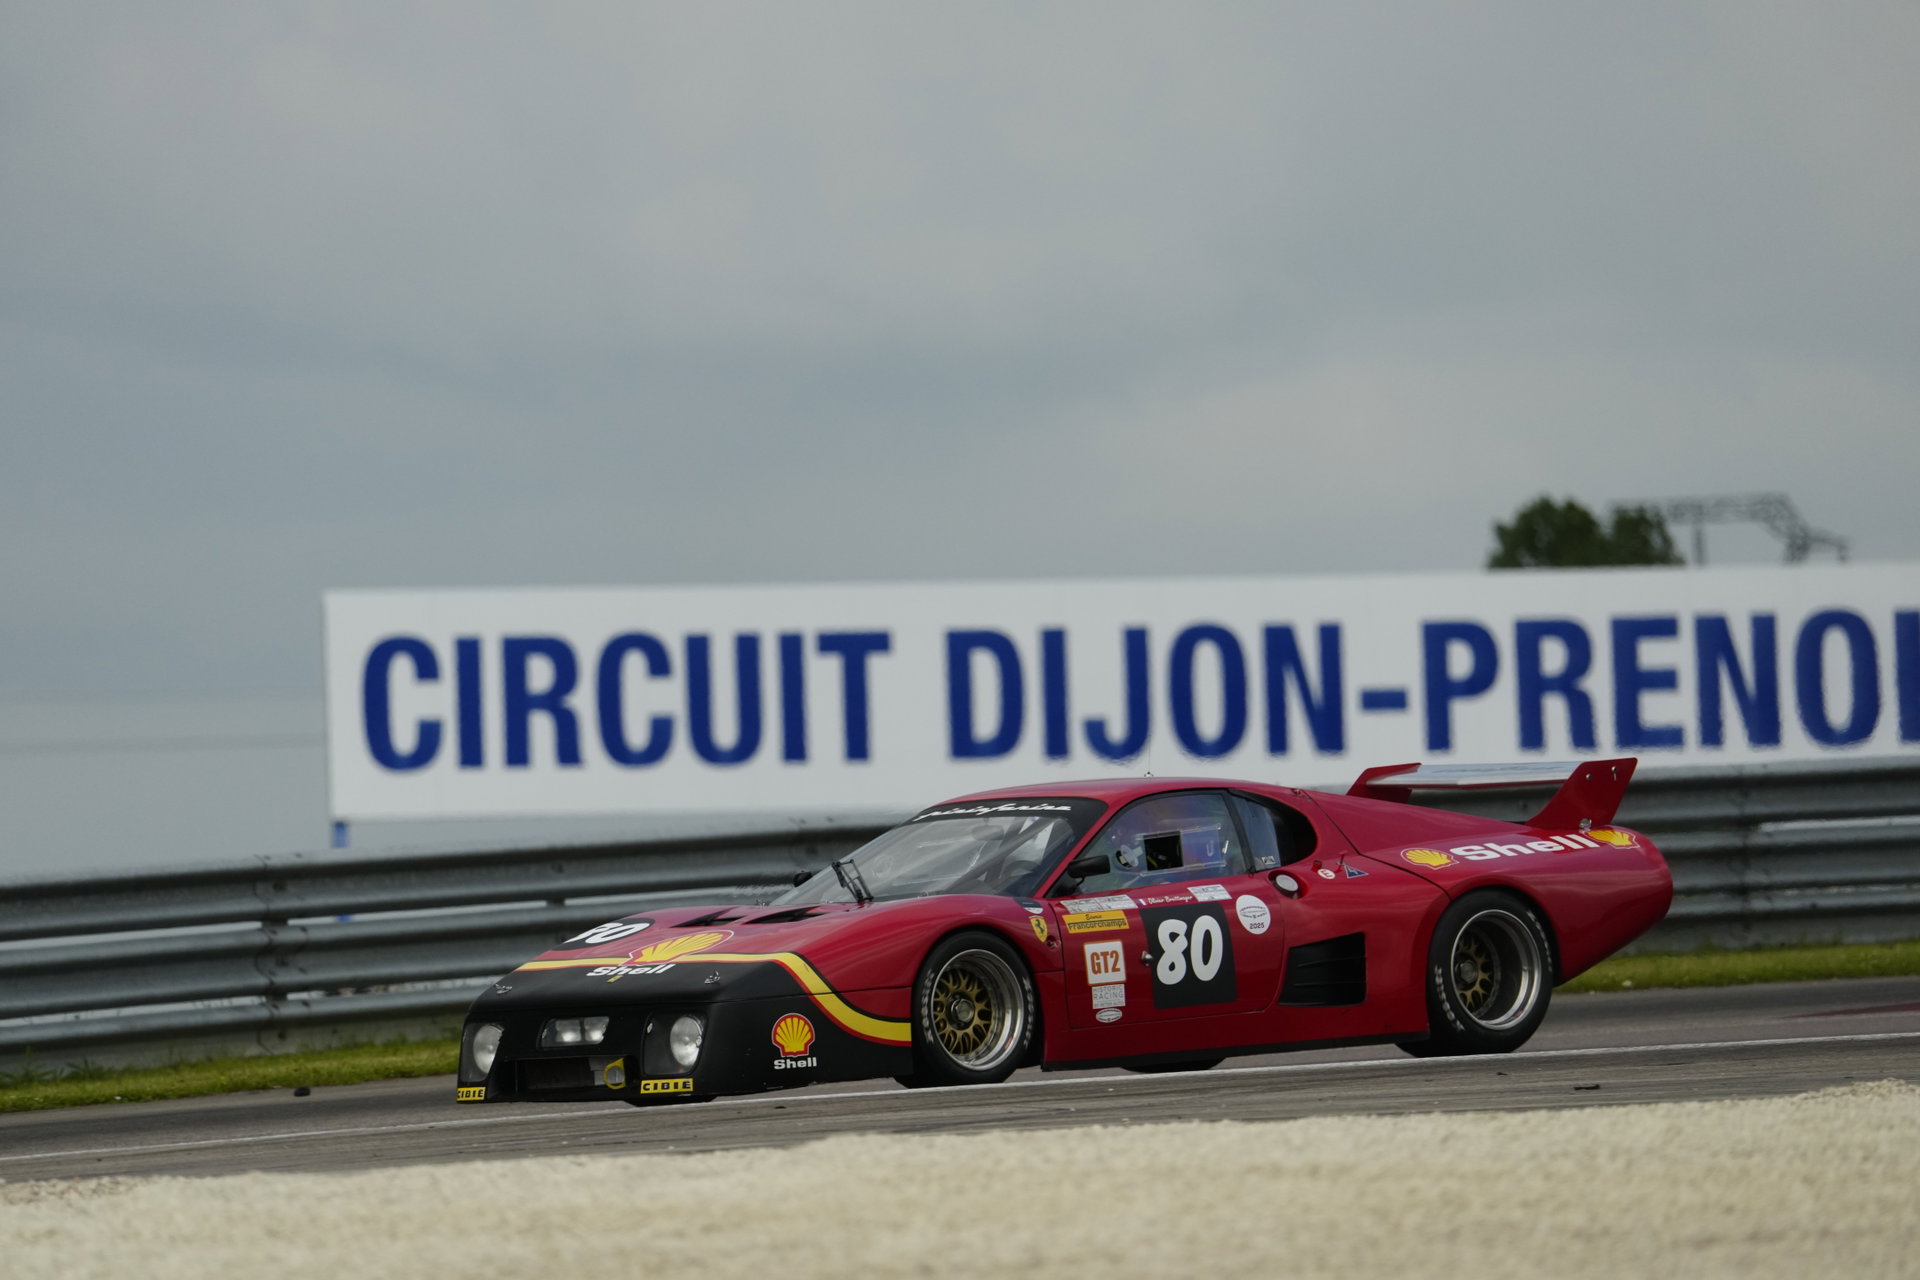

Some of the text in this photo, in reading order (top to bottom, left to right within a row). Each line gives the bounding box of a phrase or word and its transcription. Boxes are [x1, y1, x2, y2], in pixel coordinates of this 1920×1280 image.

[361, 631, 892, 772] CIRCUIT
[1449, 833, 1600, 861] Shell
[1249, 922, 1265, 930] 2025
[1156, 914, 1224, 985] 80
[1090, 950, 1121, 975] GT2
[586, 963, 676, 977] Shell
[1094, 991, 1123, 1001] RACING
[773, 1057, 818, 1070] Shell
[643, 1081, 692, 1091] CIBIE
